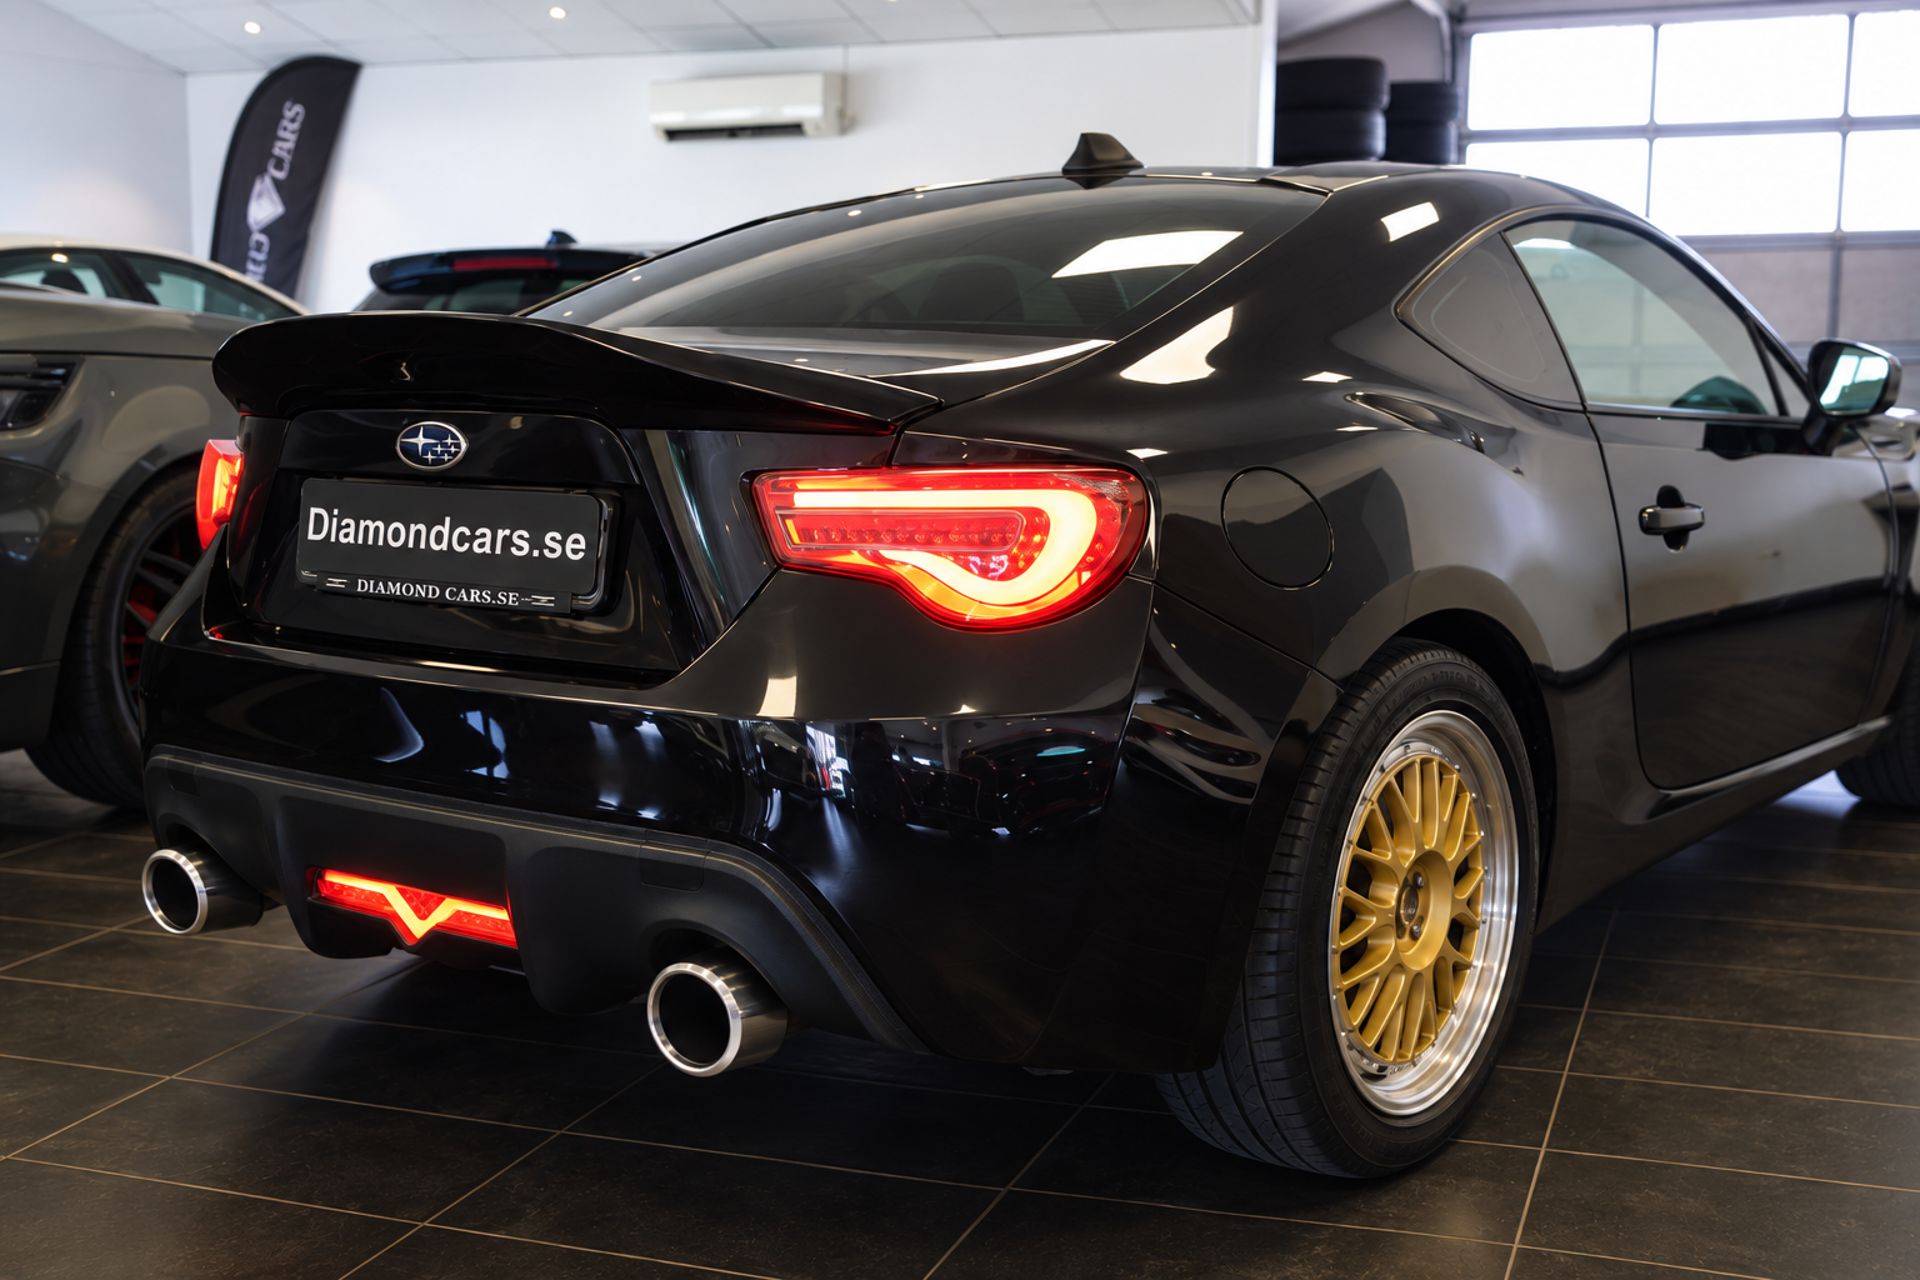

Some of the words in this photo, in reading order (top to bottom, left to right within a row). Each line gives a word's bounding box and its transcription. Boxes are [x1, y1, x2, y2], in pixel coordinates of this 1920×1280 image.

[266, 99, 306, 181] CARS
[306, 507, 587, 561] Diamondcars.se
[356, 578, 440, 599] DIAMOND
[445, 587, 519, 606] CARS.SE
